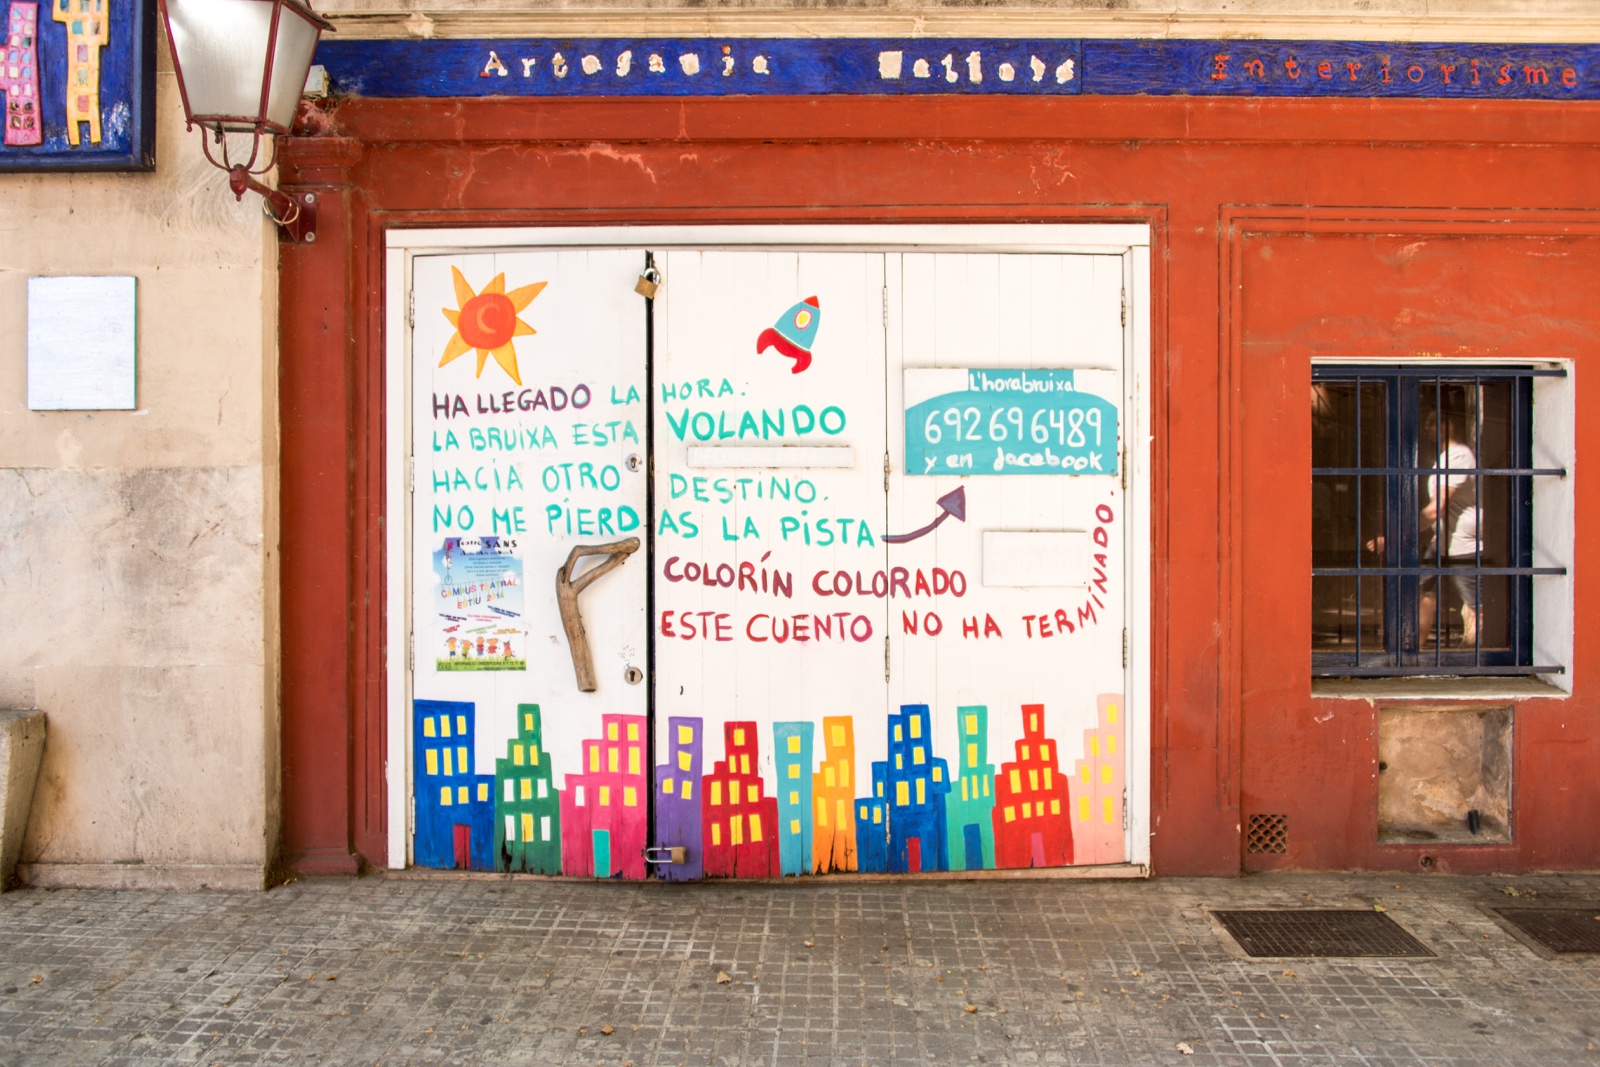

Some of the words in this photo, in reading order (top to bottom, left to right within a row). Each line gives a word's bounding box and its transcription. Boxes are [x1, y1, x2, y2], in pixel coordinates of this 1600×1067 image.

[1211, 55, 1577, 87] Interiorisme
[432, 393, 470, 419] HA
[477, 383, 592, 414] LLEGADO
[611, 384, 640, 405] LA
[432, 429, 459, 452] LA
[571, 420, 640, 447] ESTA
[665, 404, 846, 442] VOLANDO
[924, 407, 982, 444] 692
[989, 407, 1024, 441] 69
[1031, 408, 1102, 448] 6489
[542, 462, 621, 493] OTRO
[946, 453, 973, 469] en
[432, 504, 475, 534] NO
[492, 506, 527, 536] ME
[722, 516, 760, 542] LA
[485, 540, 518, 548] SANS
[441, 584, 477, 598] CAMPUS
[479, 580, 518, 591] TEATRAL
[663, 550, 793, 599] COLORÍN
[812, 566, 967, 599] COLORADO
[661, 611, 734, 642] ESTE
[746, 613, 873, 644] CUENTO
[902, 610, 943, 636] NO
[963, 612, 1003, 639] HA
